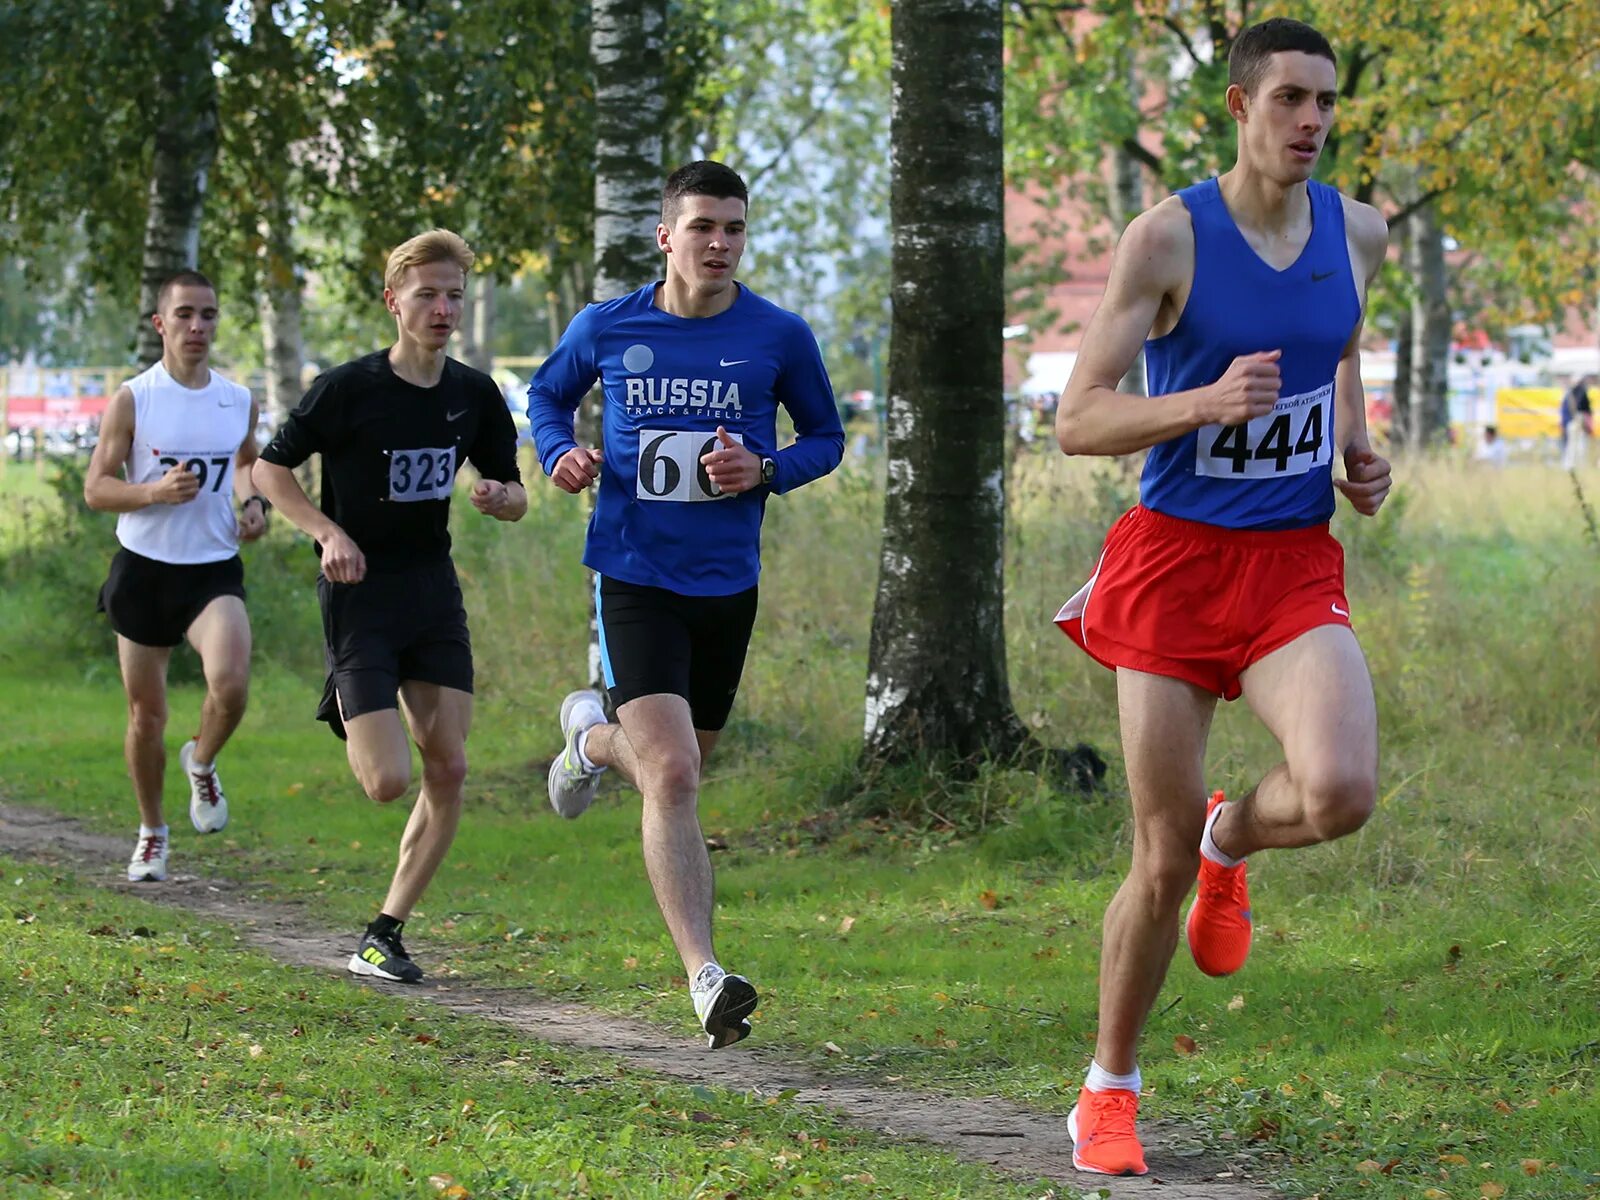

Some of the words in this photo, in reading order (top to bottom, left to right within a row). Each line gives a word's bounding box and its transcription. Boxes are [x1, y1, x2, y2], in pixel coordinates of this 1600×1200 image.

[626, 378, 742, 410] RUSSIA
[626, 407, 676, 415] TRACK
[697, 409, 742, 419] FIELD
[1210, 402, 1323, 473] 444
[393, 453, 451, 494] 323
